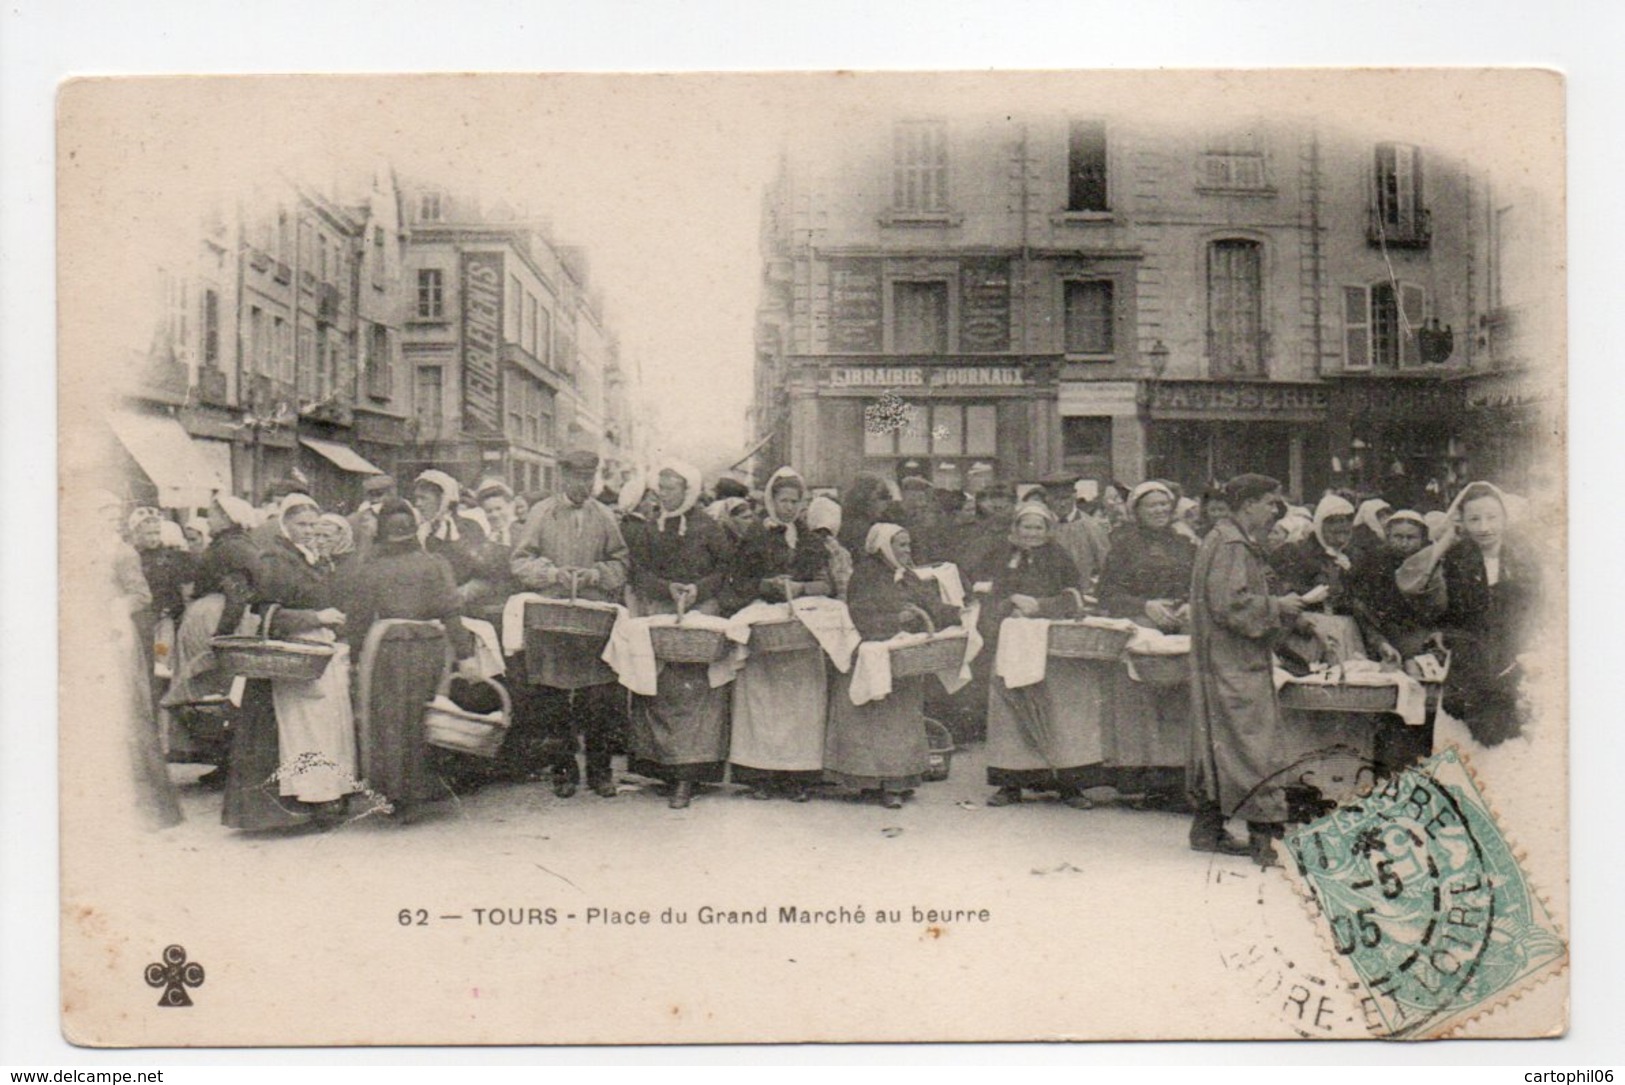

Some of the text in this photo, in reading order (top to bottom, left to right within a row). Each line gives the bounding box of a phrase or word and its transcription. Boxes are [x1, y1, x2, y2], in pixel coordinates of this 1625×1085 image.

[466, 260, 499, 432] AMEUBLEMENTS
[831, 367, 1024, 388] LIBRAIRIE JOURNAUX
[398, 908, 430, 926] 62
[472, 908, 558, 925] TOURS
[586, 907, 651, 924] Place
[660, 907, 688, 923] du
[698, 906, 768, 924] Grand
[778, 905, 866, 923] Marché
[875, 909, 901, 923] au
[912, 905, 991, 923] beurre
